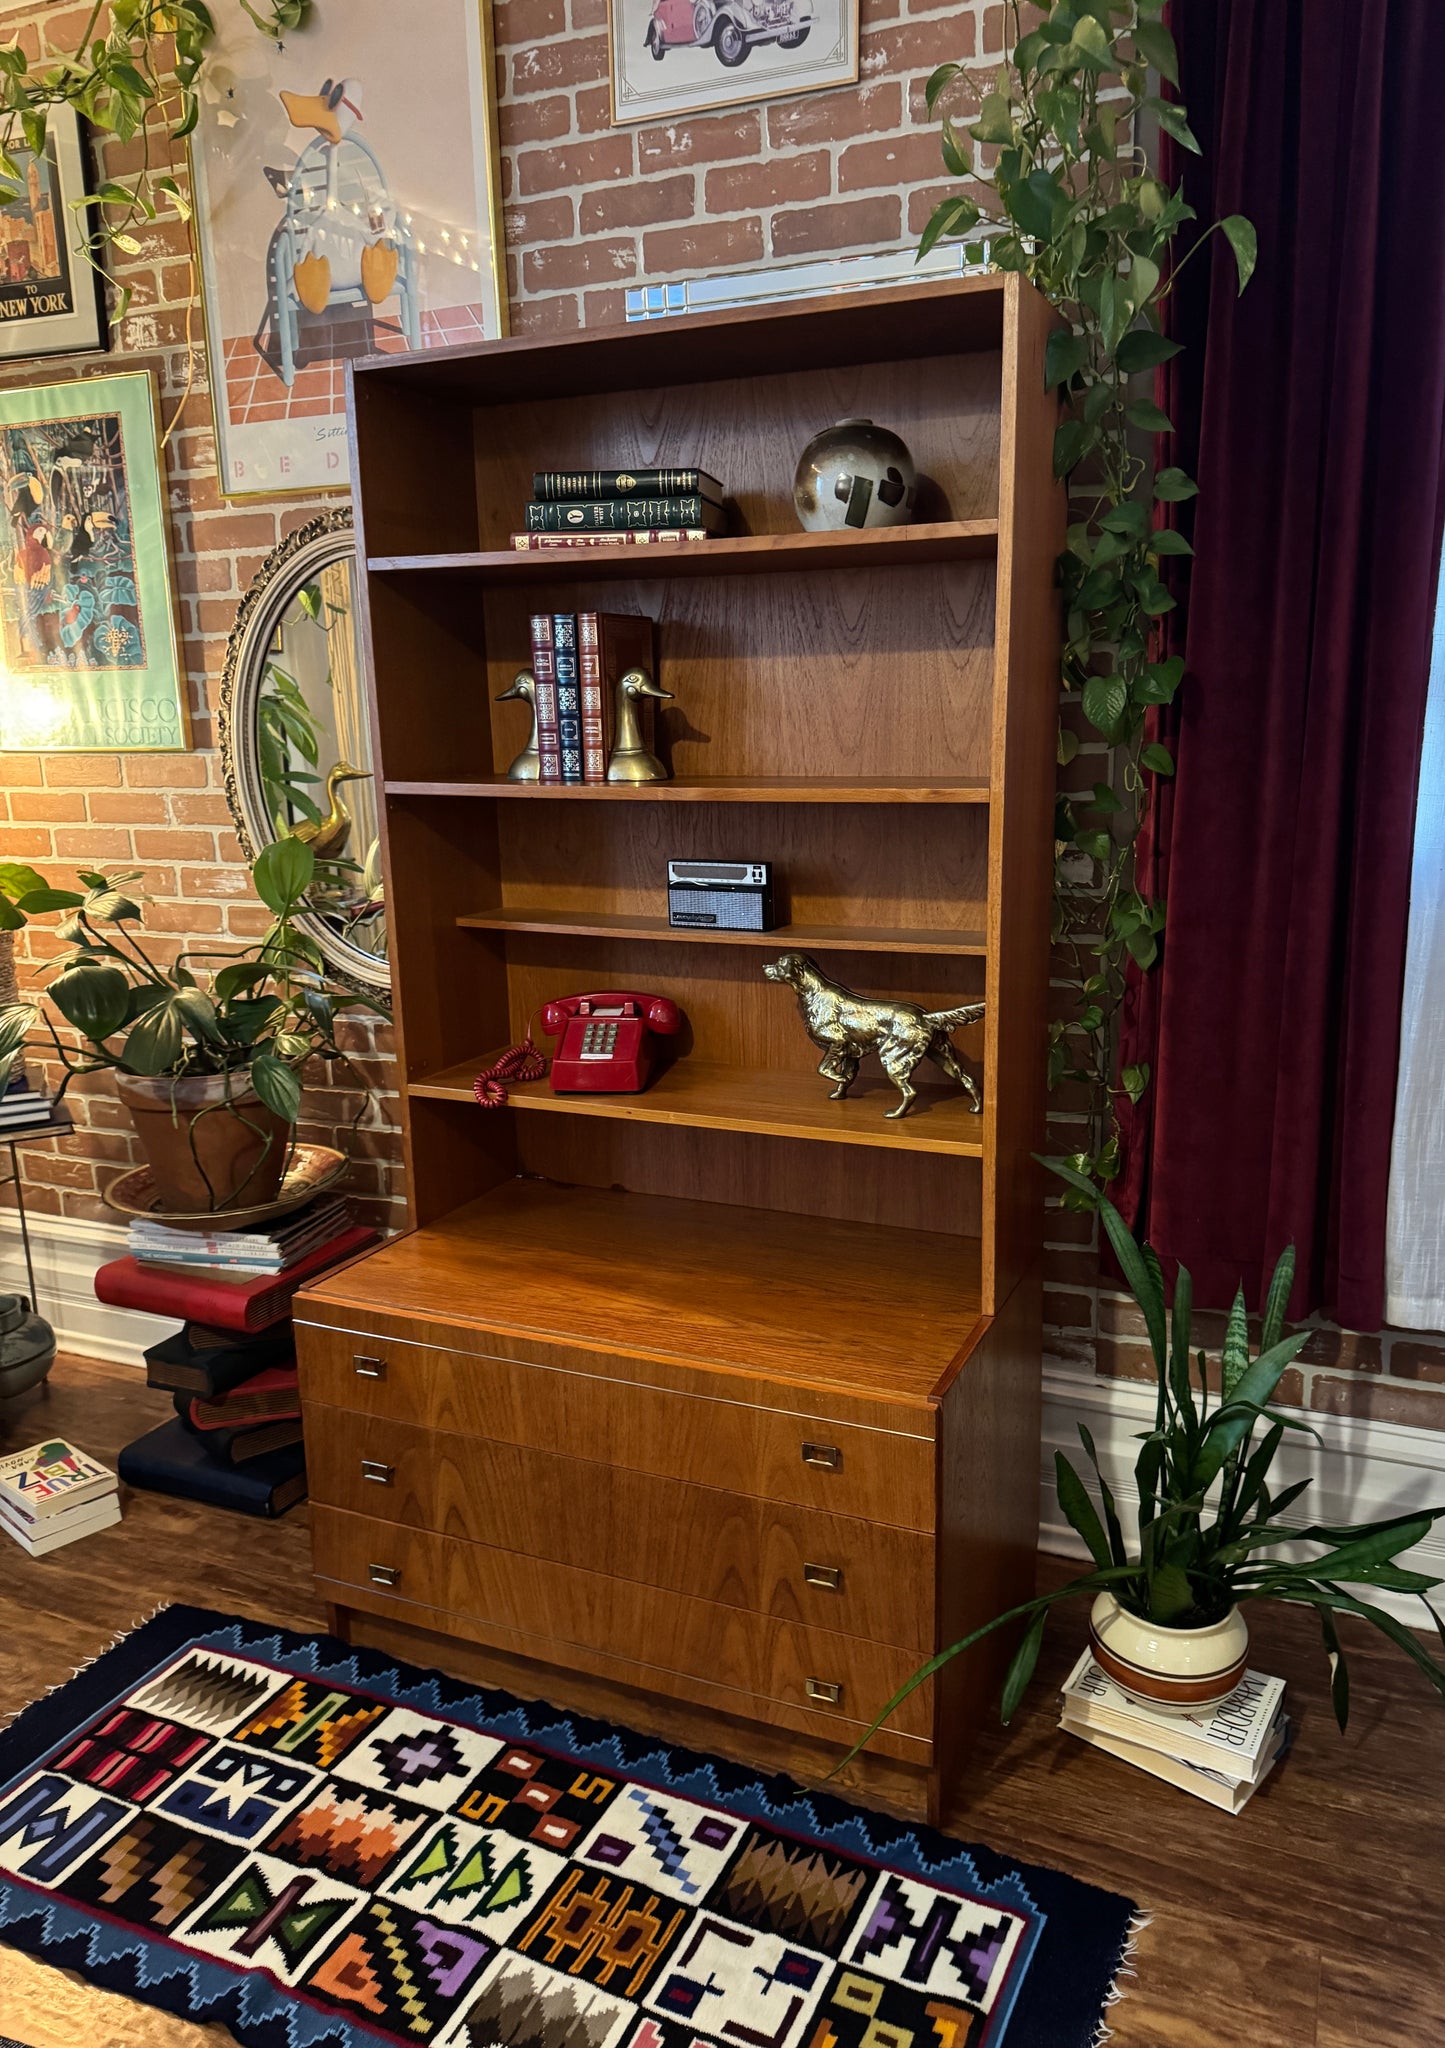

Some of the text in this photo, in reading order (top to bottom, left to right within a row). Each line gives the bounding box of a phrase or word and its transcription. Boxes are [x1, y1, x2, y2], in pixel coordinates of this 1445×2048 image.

[7, 139, 21, 150] OR
[25, 284, 38, 295] TO
[0, 292, 69, 318] NEW YORK
[104, 726, 178, 745] SOCIETY
[5, 1464, 70, 1489] BIZ
[22, 1463, 107, 1500] TRUE
[1206, 1675, 1268, 1746] MURDER
